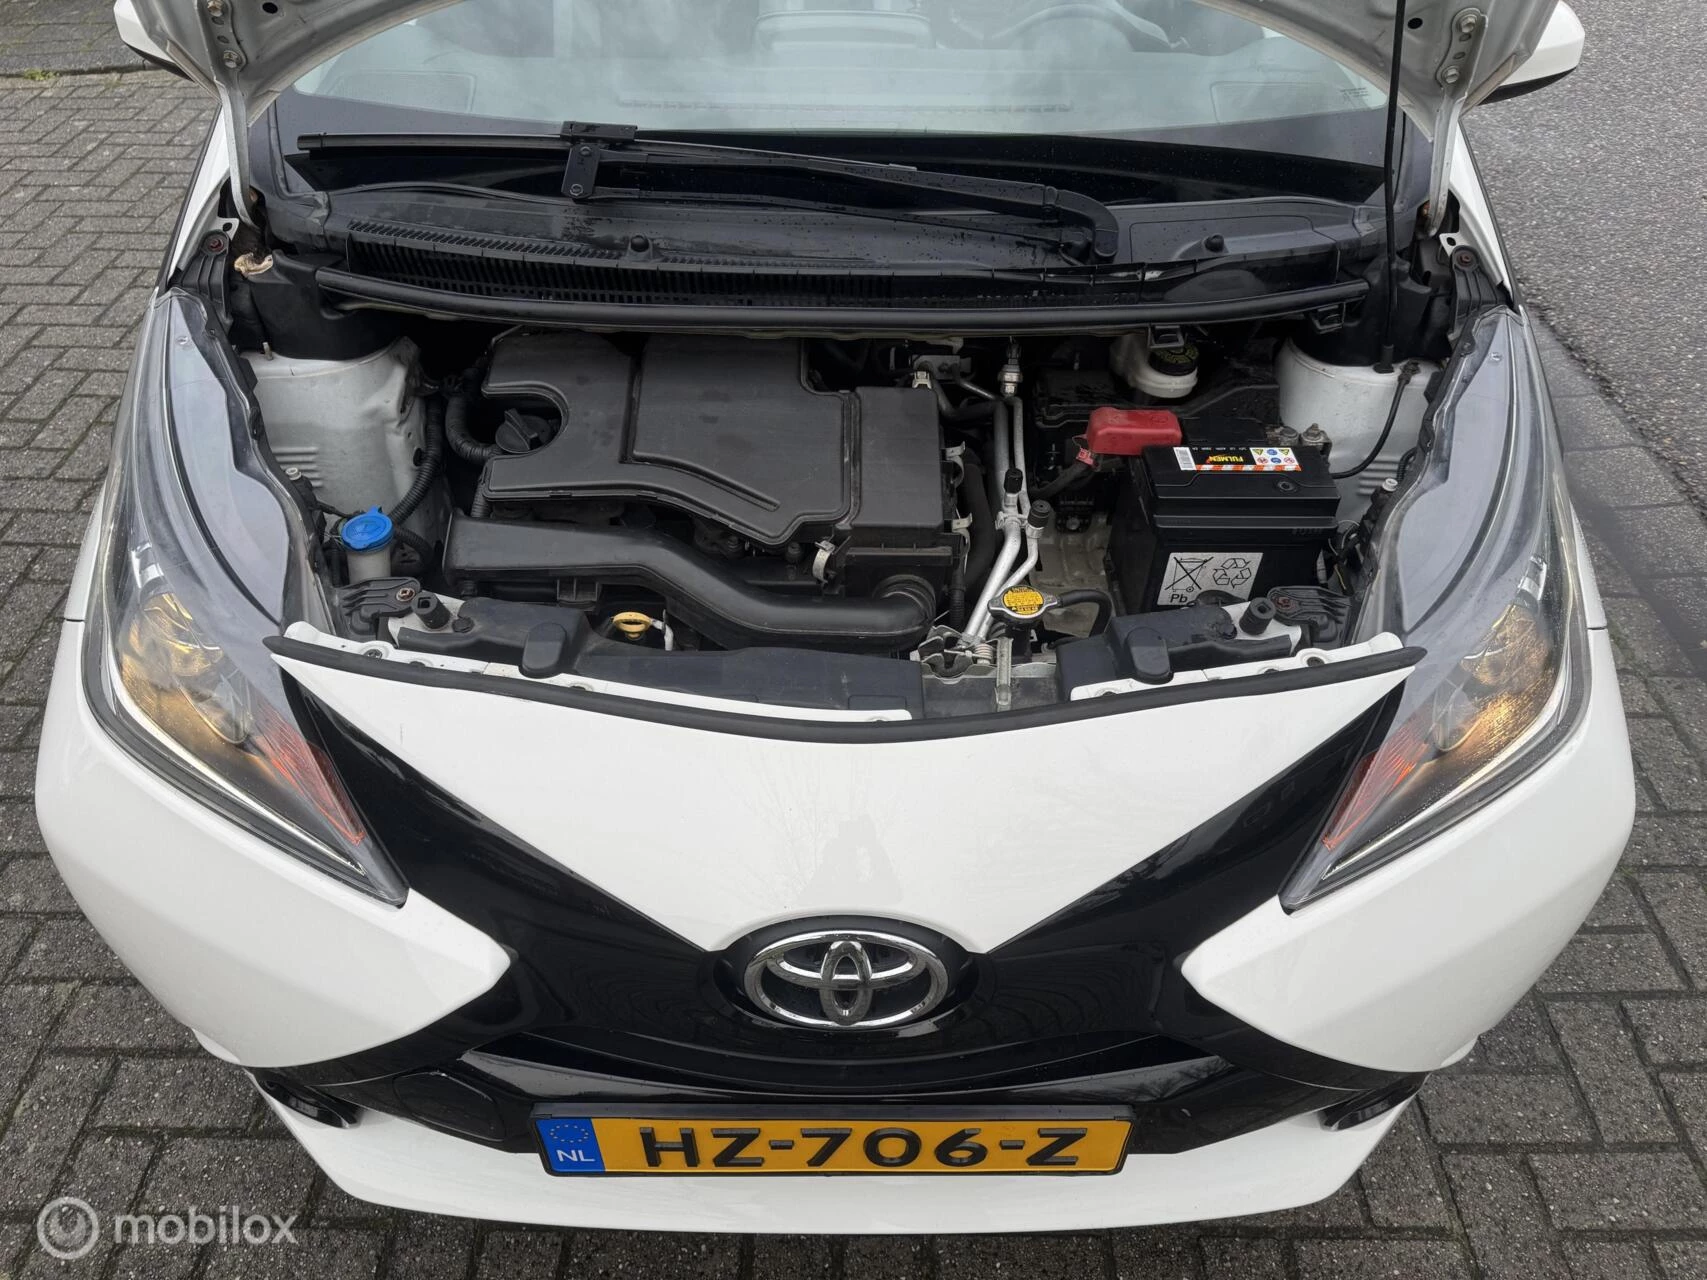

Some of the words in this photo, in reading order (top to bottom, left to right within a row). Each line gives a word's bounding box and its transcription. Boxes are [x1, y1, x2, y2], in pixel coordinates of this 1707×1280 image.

[1208, 455, 1244, 463] FULMEN
[1170, 593, 1188, 604] Pb
[639, 1127, 1088, 1167] HZ-706-Z
[556, 1149, 596, 1162] NL
